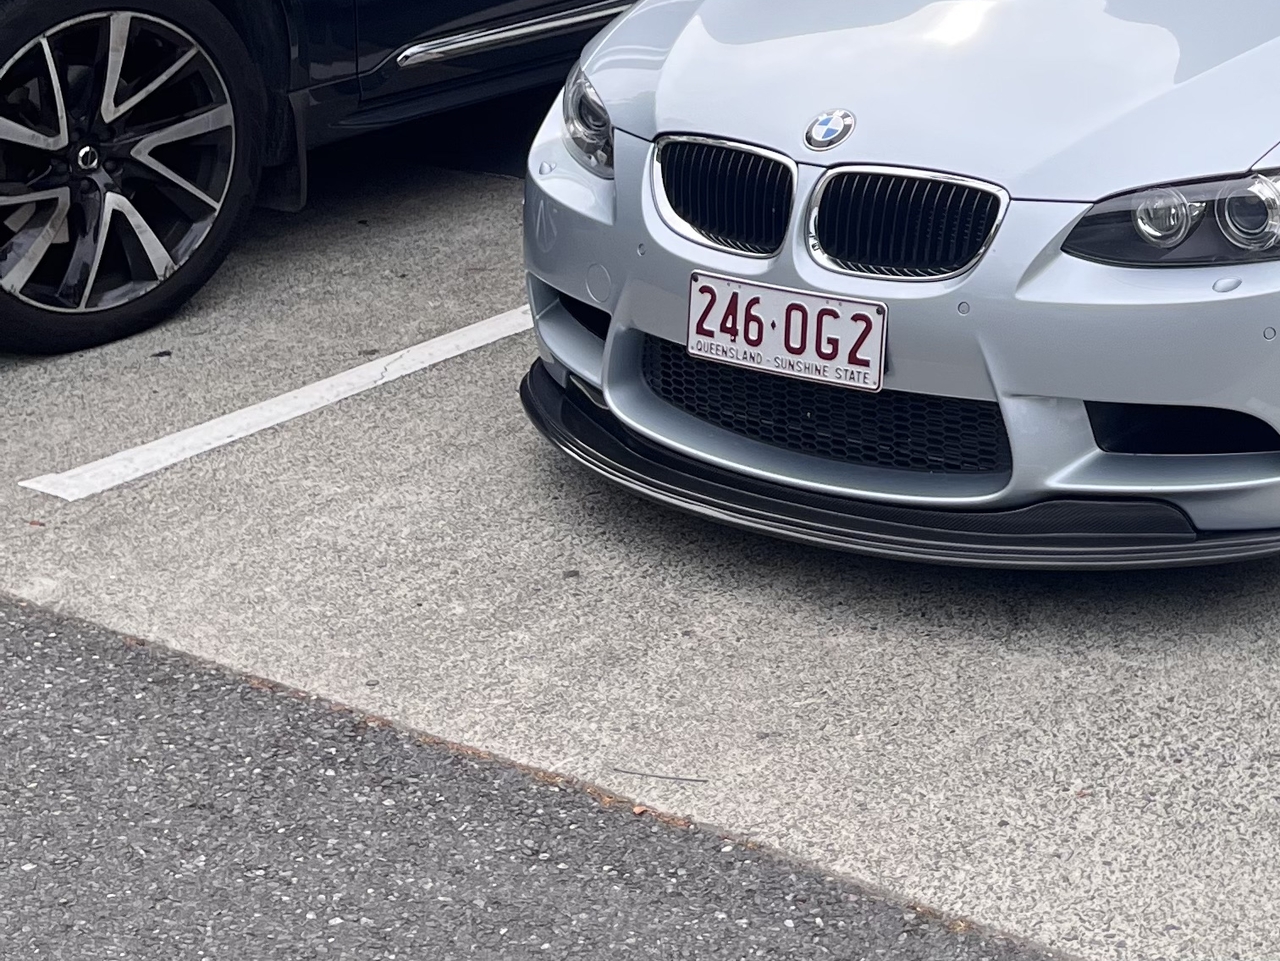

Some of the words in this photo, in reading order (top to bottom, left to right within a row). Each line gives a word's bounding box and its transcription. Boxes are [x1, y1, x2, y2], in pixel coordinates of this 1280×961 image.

[695, 339, 763, 365] QUEENSLAND
[773, 357, 830, 378] SUNSHINE
[834, 368, 870, 384] STATE
